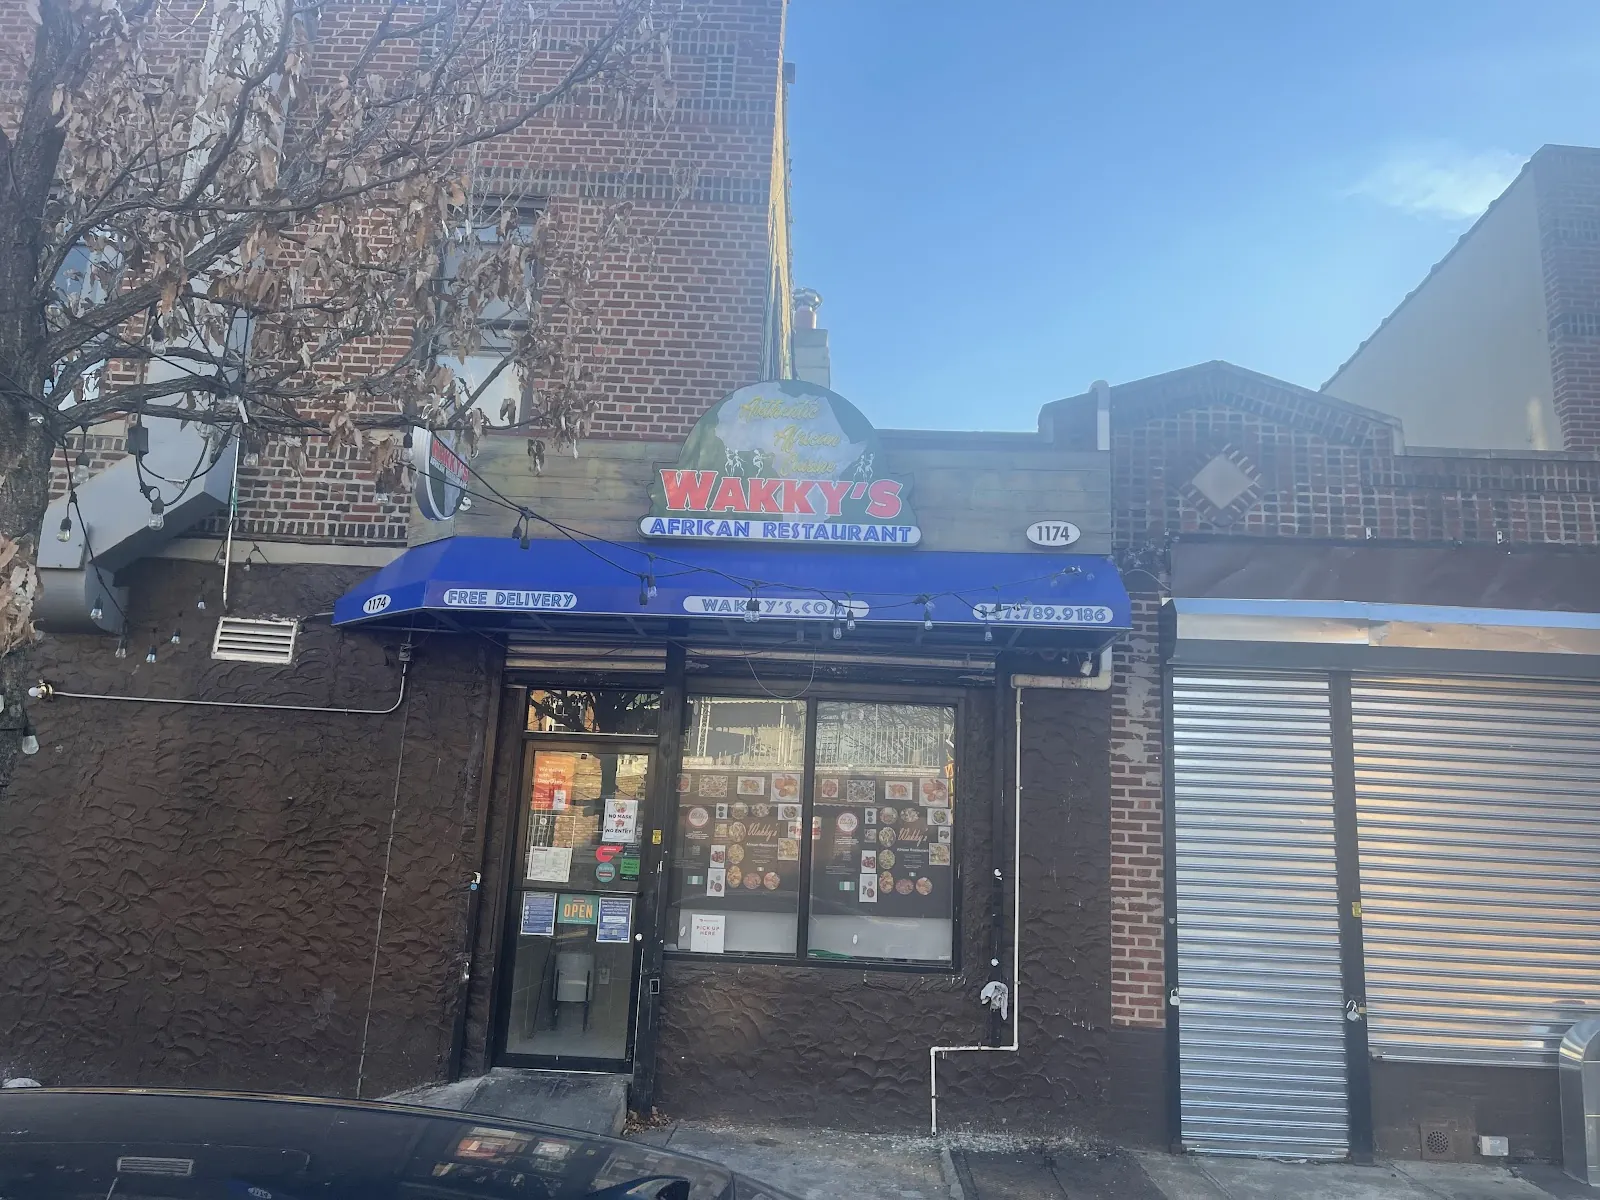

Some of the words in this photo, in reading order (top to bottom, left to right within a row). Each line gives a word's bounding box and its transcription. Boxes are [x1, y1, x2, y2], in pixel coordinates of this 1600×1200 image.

[774, 424, 839, 453] African
[659, 469, 903, 519] WAKKY'S
[650, 518, 750, 537] AFRICAN
[763, 521, 912, 543] RESTAURANT
[1037, 525, 1070, 541] 1174
[367, 595, 388, 611] 1174
[447, 590, 488, 605] FREE
[495, 591, 574, 607] DELIVERY
[563, 903, 593, 919] OPEN
